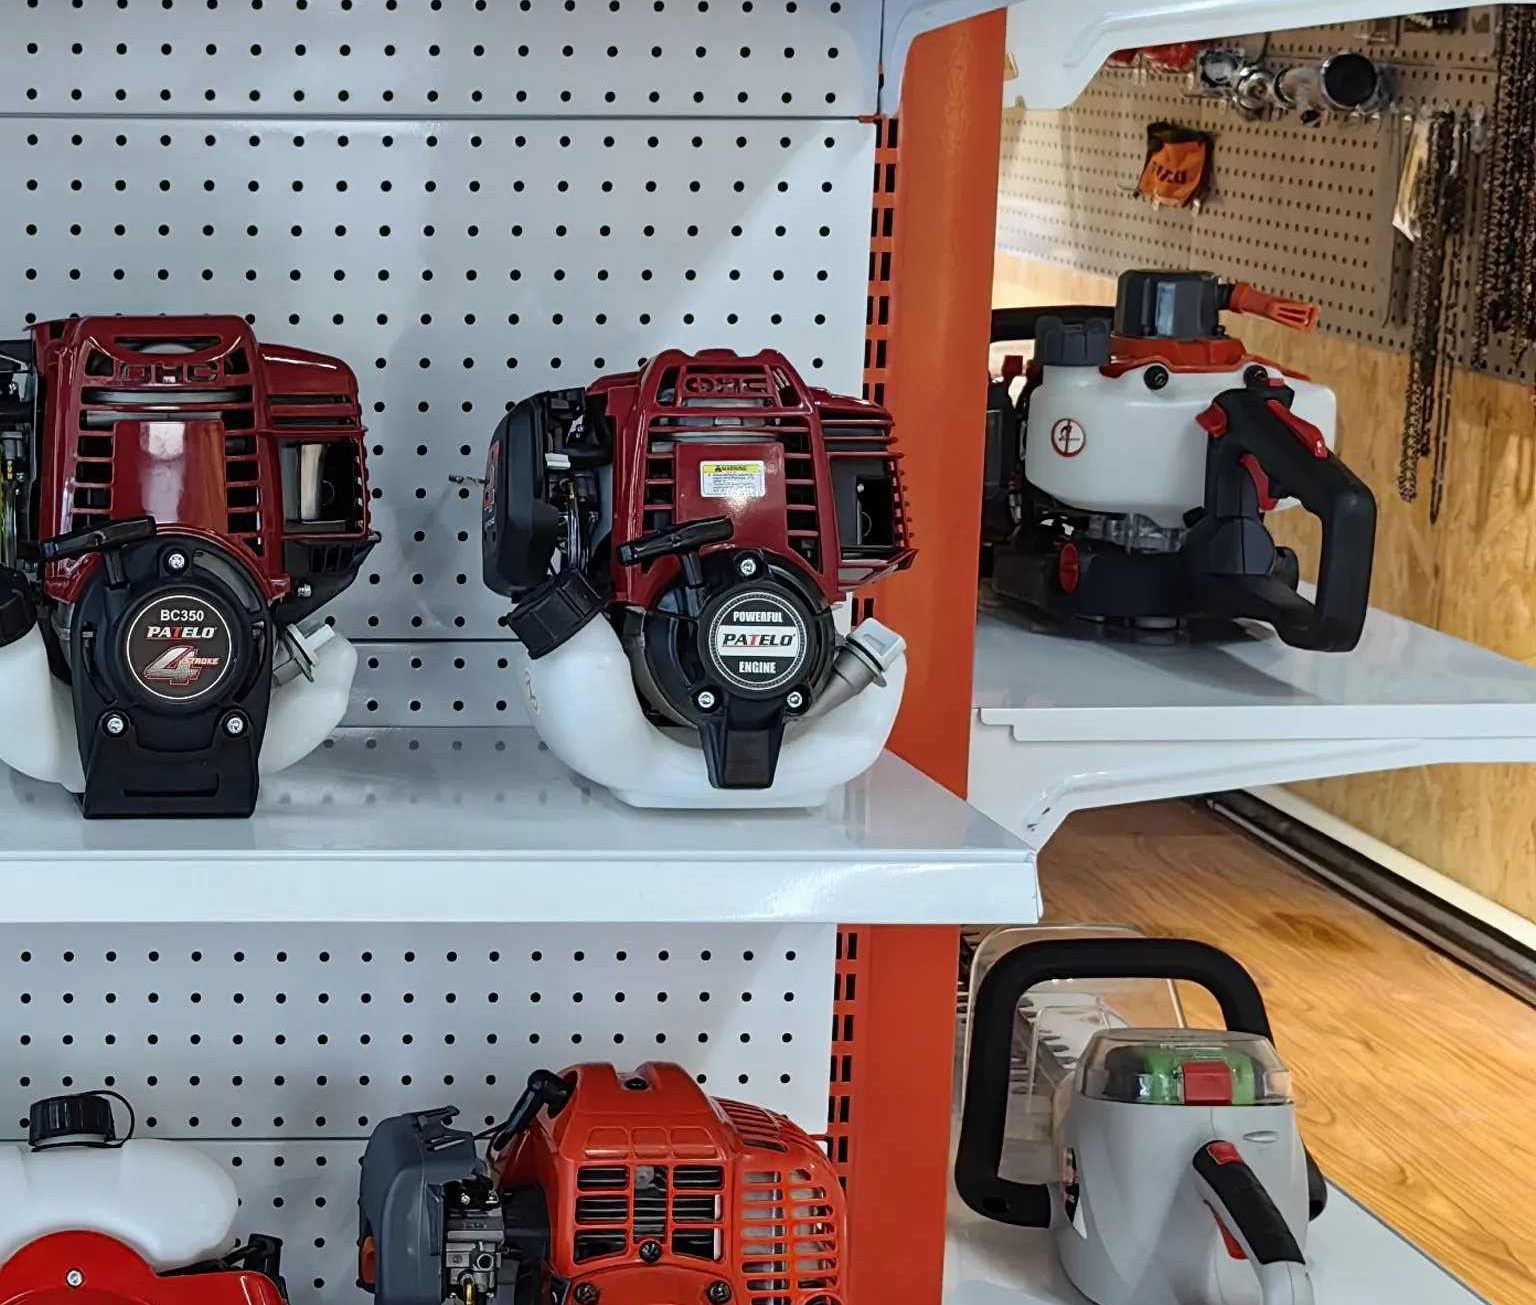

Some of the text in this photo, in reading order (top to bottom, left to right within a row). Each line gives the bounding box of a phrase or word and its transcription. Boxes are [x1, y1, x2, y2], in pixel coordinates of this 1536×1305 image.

[160, 609, 205, 622] BC350
[733, 611, 783, 623] POWERFUL
[146, 625, 216, 640] PATELO
[722, 633, 794, 648] PATELO
[143, 645, 221, 686] 4 STROKE
[739, 661, 777, 674] ENGINE
